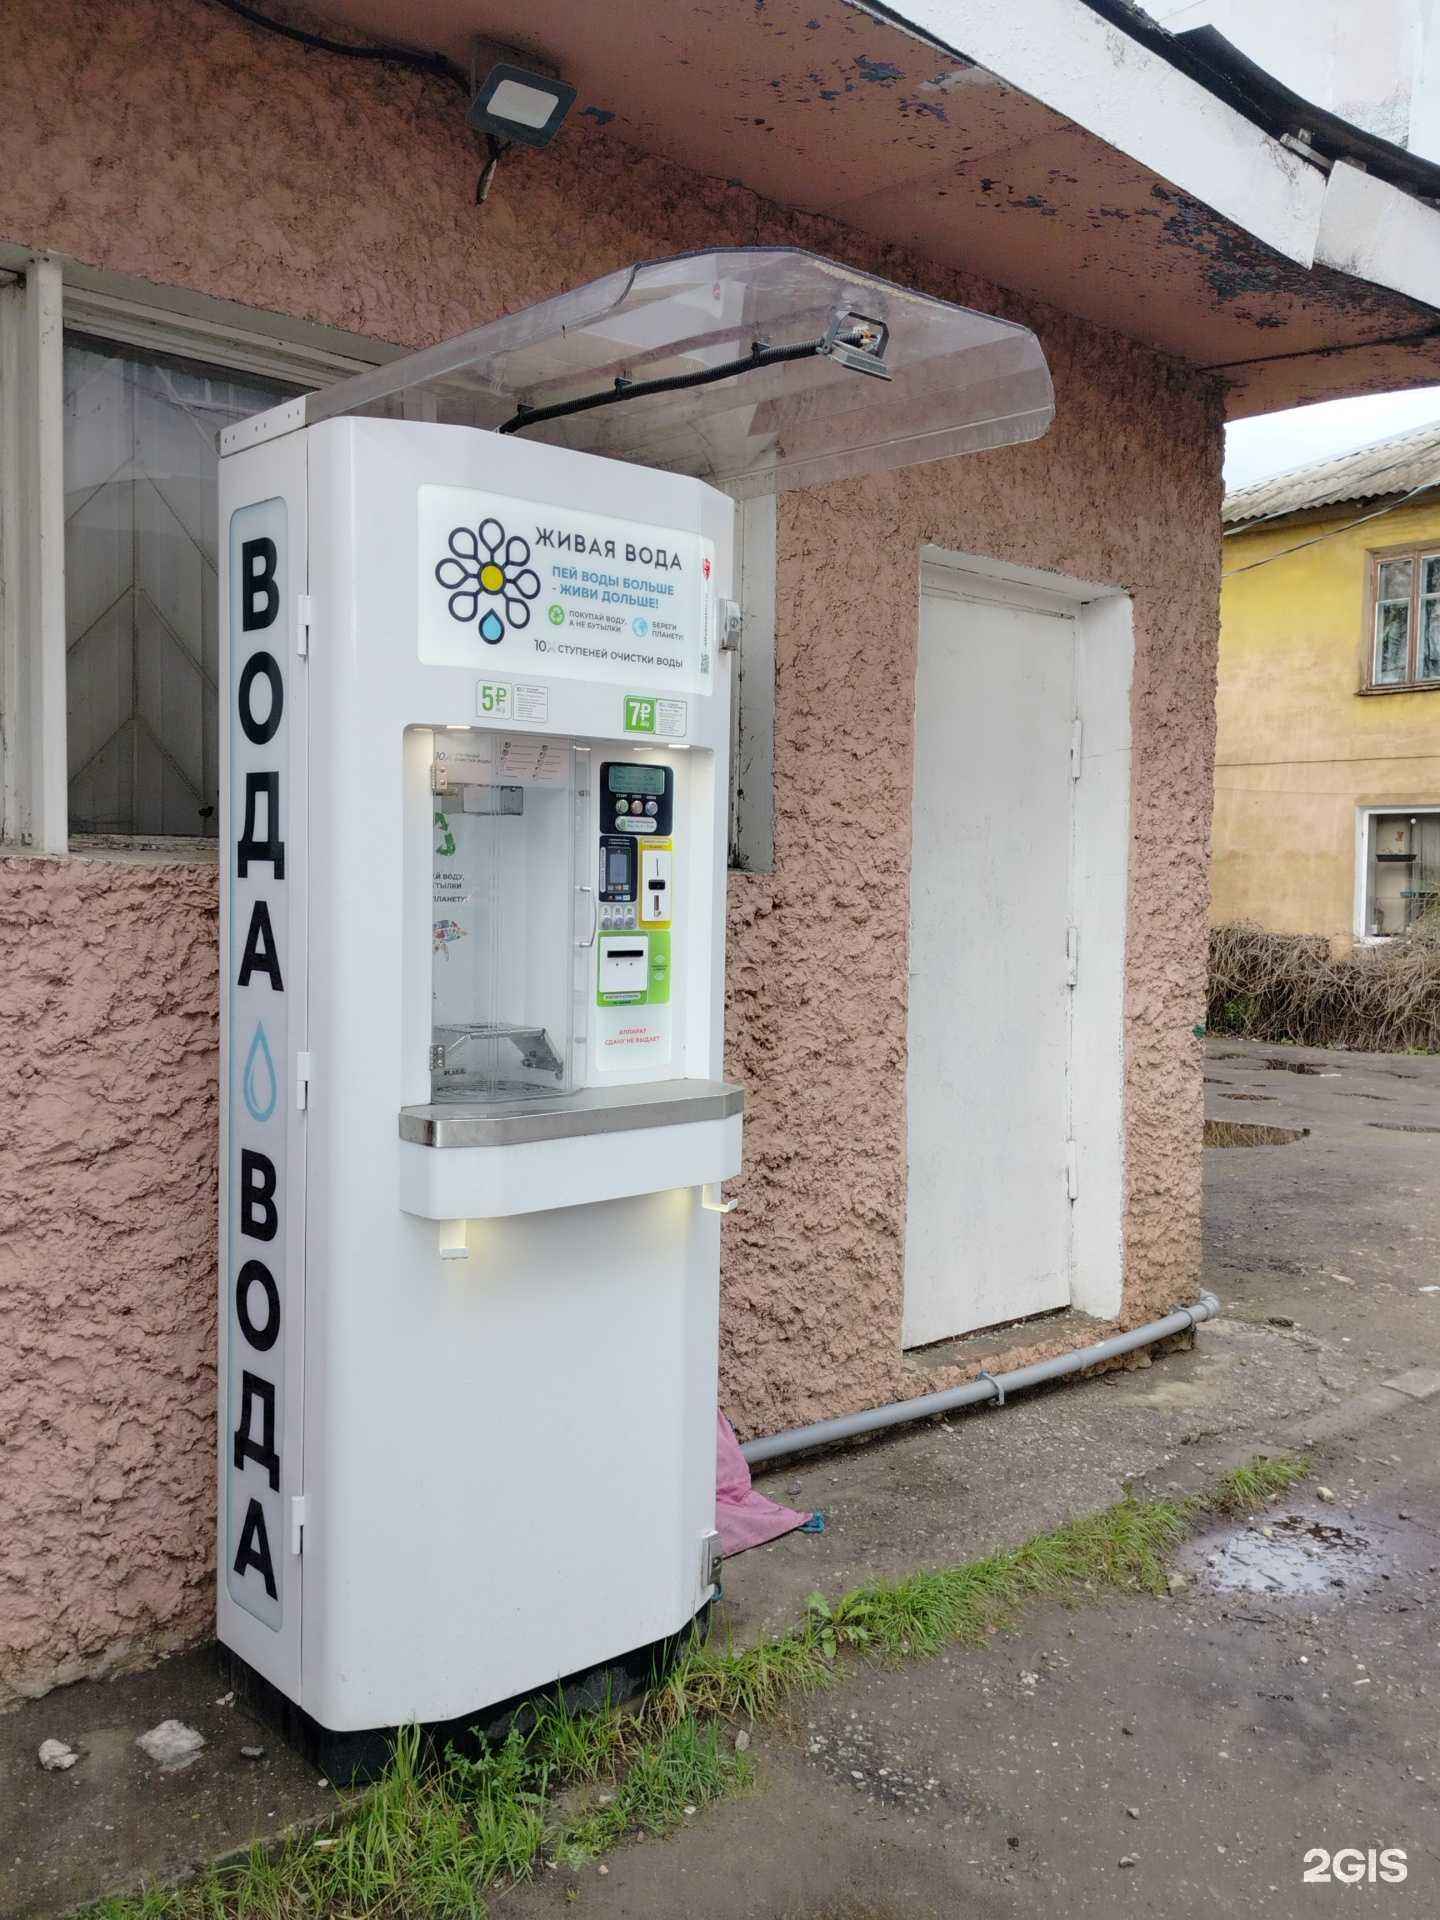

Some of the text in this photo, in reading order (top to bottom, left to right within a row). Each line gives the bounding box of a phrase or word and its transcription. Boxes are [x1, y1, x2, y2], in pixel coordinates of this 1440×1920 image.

[535, 526, 616, 559] ЖИВАЯ
[625, 543, 682, 571] ВОДА
[552, 565, 675, 596] ПЕЙ ВОДЫ БОЛЬШЕ
[560, 583, 598, 600] ЖИВИ
[601, 591, 659, 609] ДОЛЬШЕ!
[569, 610, 605, 623] ПОКУПАЙ
[576, 621, 586, 629] НЕ
[587, 622, 622, 633] БУТЫЛКИ
[652, 621, 677, 631] БЕРЕГИ
[558, 644, 608, 659] СТУПЕНЕЙ
[610, 650, 654, 665] ОЧИСТКИ
[656, 656, 683, 668] ВОДЫ
[237, 537, 285, 992] ВОДА
[233, 1147, 281, 1602] ВОДА
